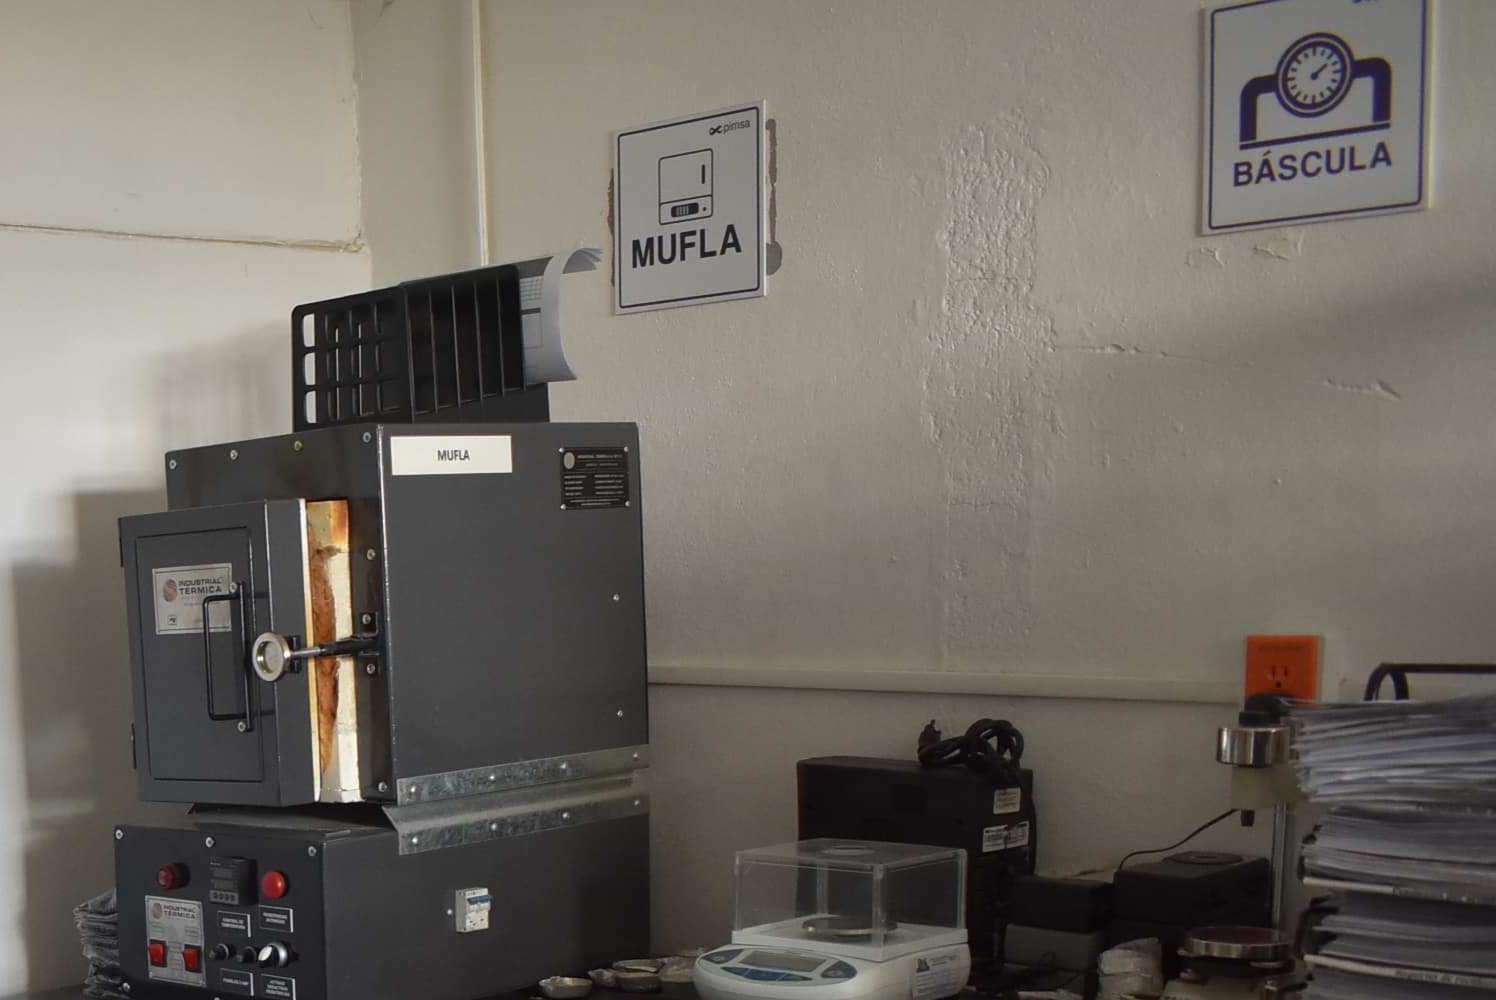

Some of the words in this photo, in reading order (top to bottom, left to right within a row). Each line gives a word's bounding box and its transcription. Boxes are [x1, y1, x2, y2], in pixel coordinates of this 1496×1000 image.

[722, 119, 751, 135] pimsa
[1233, 141, 1393, 187] BÁSCULA
[632, 223, 742, 268] MUFLA
[437, 450, 471, 462] MUFLA
[178, 578, 222, 588] INDUSTRIAL
[179, 585, 223, 595] TERMICA
[164, 910, 196, 920] TERMICA
